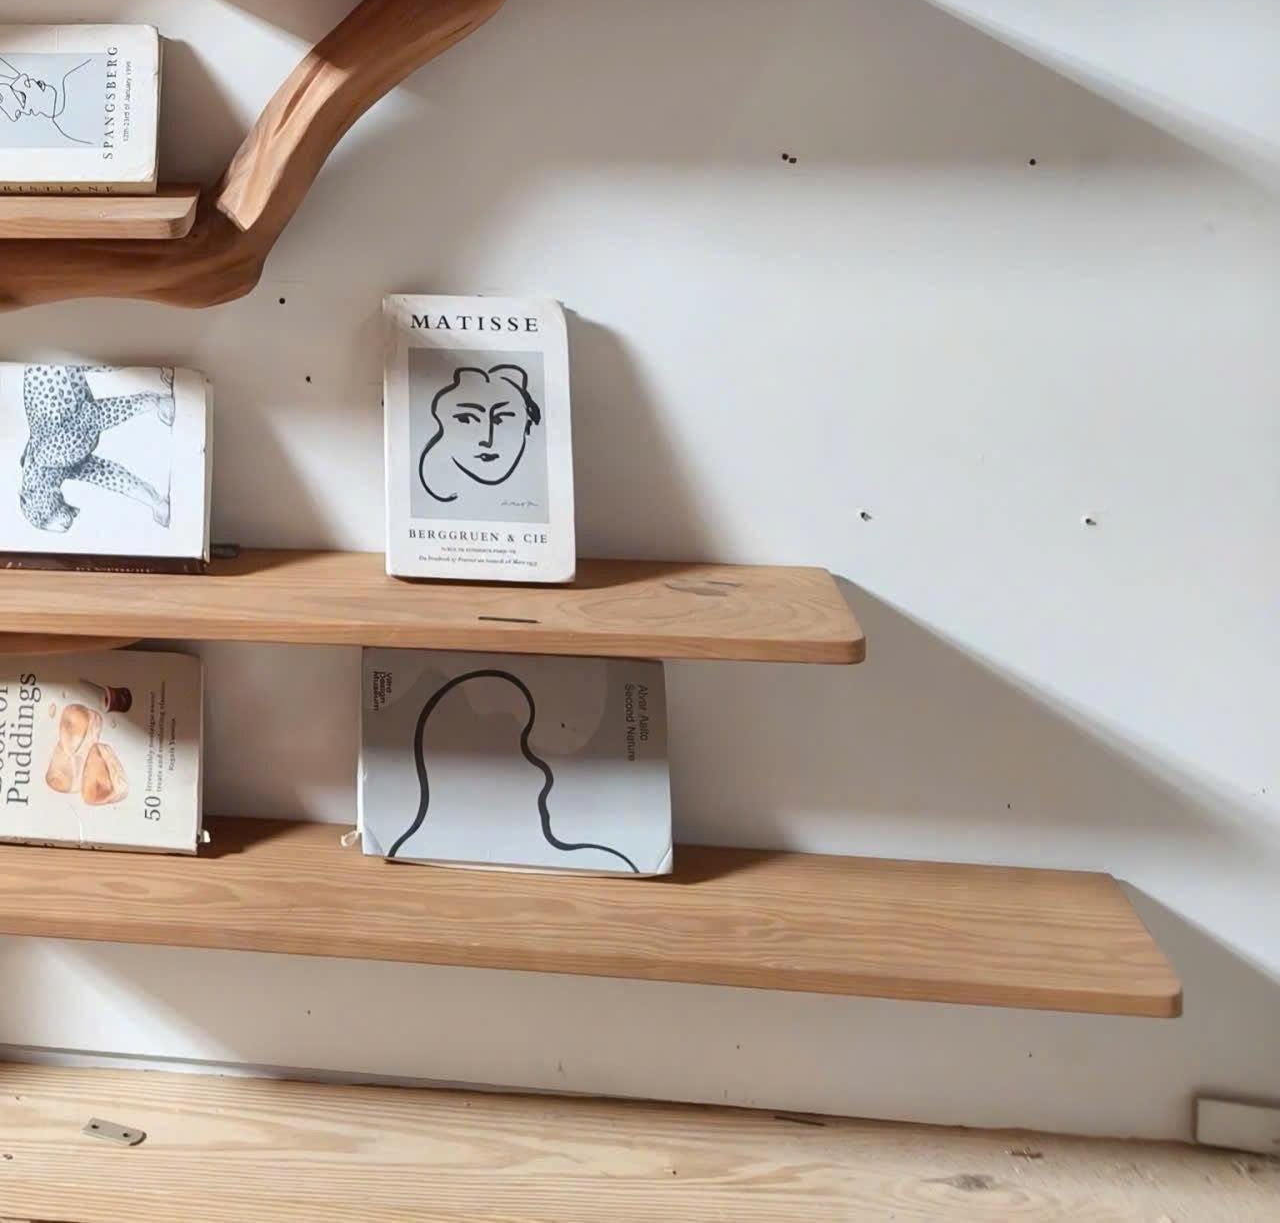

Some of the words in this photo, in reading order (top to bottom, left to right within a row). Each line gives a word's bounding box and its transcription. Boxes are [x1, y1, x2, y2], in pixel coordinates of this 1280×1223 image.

[102, 46, 119, 160] SPANGSBERG
[410, 314, 540, 333] MATISSE
[409, 529, 500, 543] BERGGRUEN
[507, 534, 516, 544] &
[523, 533, 549, 545] CIE
[624, 683, 636, 723] Second
[637, 683, 650, 711] Alvar
[6, 673, 42, 806] Puddings
[625, 726, 637, 762] Nature
[144, 795, 161, 821] 50
